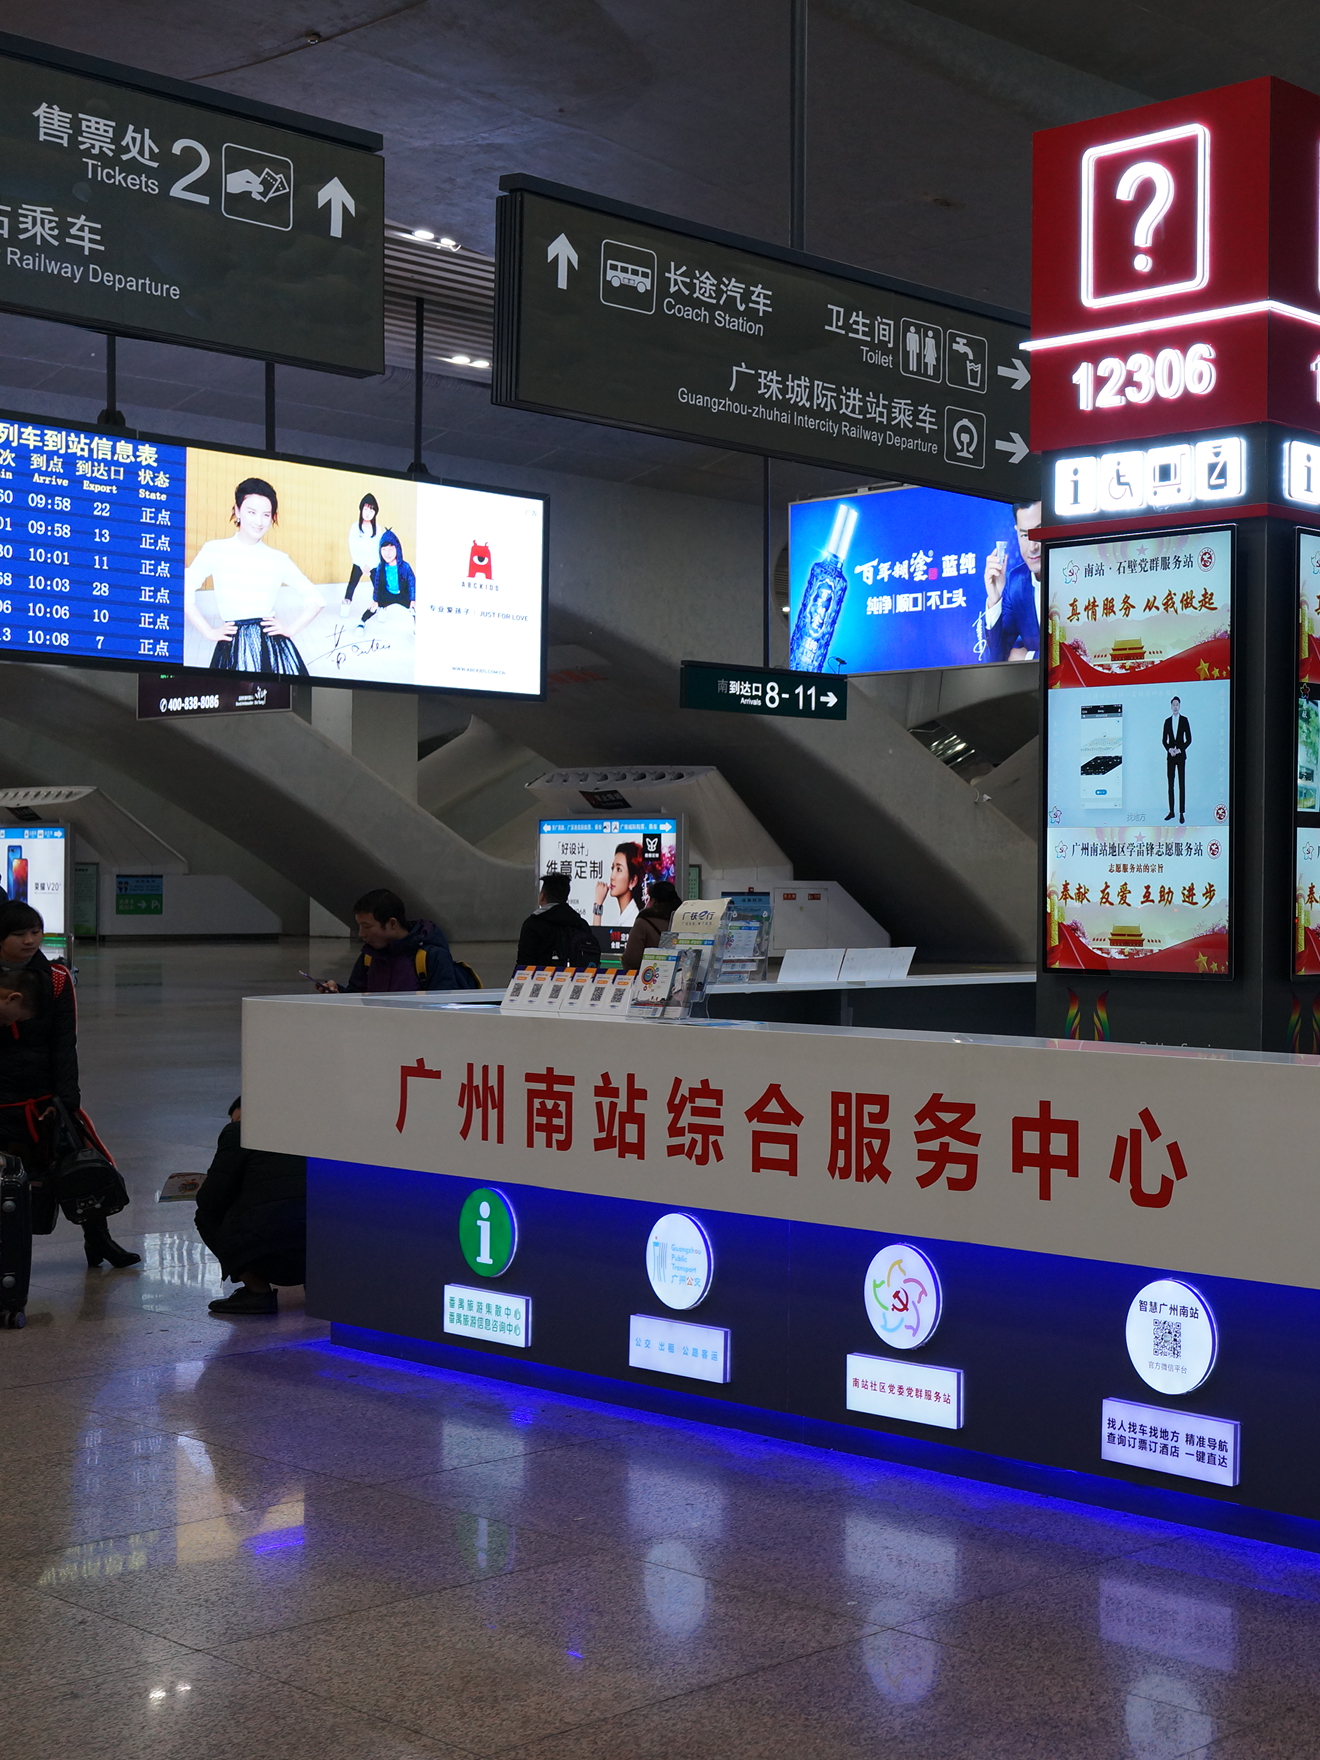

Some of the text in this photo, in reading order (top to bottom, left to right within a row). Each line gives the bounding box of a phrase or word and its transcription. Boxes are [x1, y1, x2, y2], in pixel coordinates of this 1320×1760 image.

[33, 102, 211, 205] 售票处 2
[82, 158, 160, 195] Tickets
[7, 247, 181, 299] Railway Departure
[664, 261, 773, 317] 长途汽车
[663, 299, 764, 337] Coach Station
[824, 304, 894, 348] 卫生间
[860, 345, 894, 369] Toilet
[1071, 343, 1216, 411] 12306
[729, 362, 938, 434] 广珠城际进站乘车
[677, 386, 939, 456] Guangzhou-zhuhai Intercity Railway Departure
[30, 453, 64, 473] 到点
[76, 460, 124, 481] 到达口
[138, 468, 170, 488] 状态
[33, 473, 167, 501] Arrive Export State
[28, 493, 111, 517] 09:58 22
[140, 507, 171, 526] 正点
[28, 520, 110, 542] 09:58 13
[140, 533, 170, 551] 正点
[29, 548, 109, 569] 10:01 11
[140, 559, 170, 577] 正点
[28, 576, 109, 596] 10:03 28
[139, 586, 170, 604] 正点
[461, 581, 499, 591] ABCKIDS
[28, 603, 109, 622] 10:06 10
[1066, 587, 1218, 623] 真情服务 从我做起
[139, 613, 170, 630] 正点
[497, 612, 511, 620] FOR
[512, 614, 528, 622] LOVE
[27, 630, 104, 649] 10:08 7
[138, 639, 169, 656] 正点
[168, 694, 219, 711] 400-838-8086
[740, 697, 762, 706] Arrivals
[1058, 880, 1217, 909] 奉献 友爱 互助 进步
[395, 1058, 1188, 1209] 广州南站综合服务中心
[671, 1244, 701, 1255] Guangzhou
[671, 1254, 688, 1263] Public
[671, 1263, 697, 1273] Transport
[671, 1275, 701, 1287] 广州公交
[1138, 1299, 1199, 1319] 智慧广州南站
[635, 1337, 651, 1349] 公交
[1148, 1360, 1188, 1374] 官方微信平台
[852, 1377, 951, 1405] 南站社区党委党群服务站
[1107, 1417, 1228, 1453] 找人找车找地方 精准导航
[1106, 1432, 1228, 1468] 查询订票订酒店 一键直达
